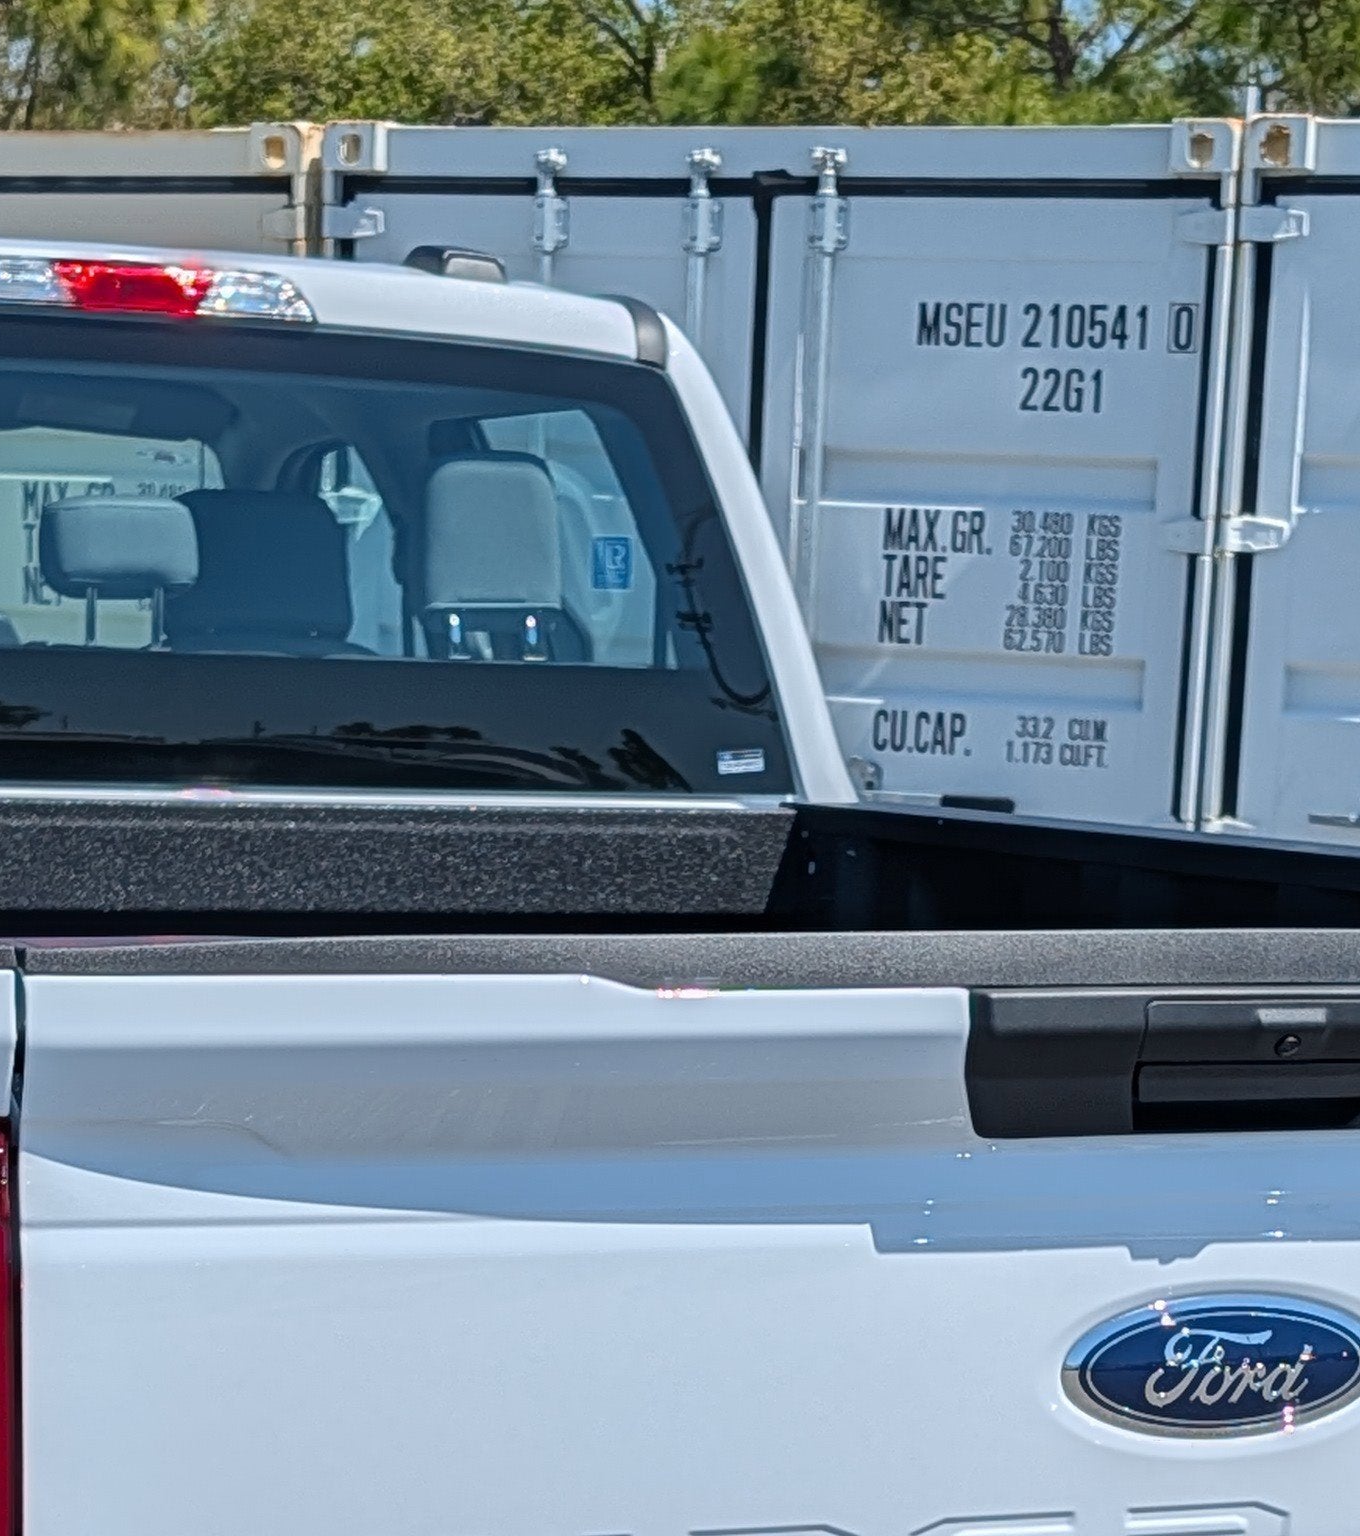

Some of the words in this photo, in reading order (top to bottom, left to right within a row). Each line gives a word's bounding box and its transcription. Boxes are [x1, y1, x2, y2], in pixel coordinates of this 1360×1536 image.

[916, 302, 1007, 347] MSEU
[1021, 303, 1148, 350] 210541
[1172, 305, 1194, 350] 0
[1019, 366, 1102, 413] 22G1
[1087, 513, 1122, 538] KGS
[1085, 537, 1120, 561] LBS
[883, 554, 947, 599] TARE
[1083, 561, 1118, 585] KGS
[1081, 585, 1116, 609] LBS
[877, 600, 928, 645] NET
[1080, 608, 1115, 633] KGS
[1078, 632, 1113, 657] LBS
[1144, 1326, 1314, 1408] Ford
